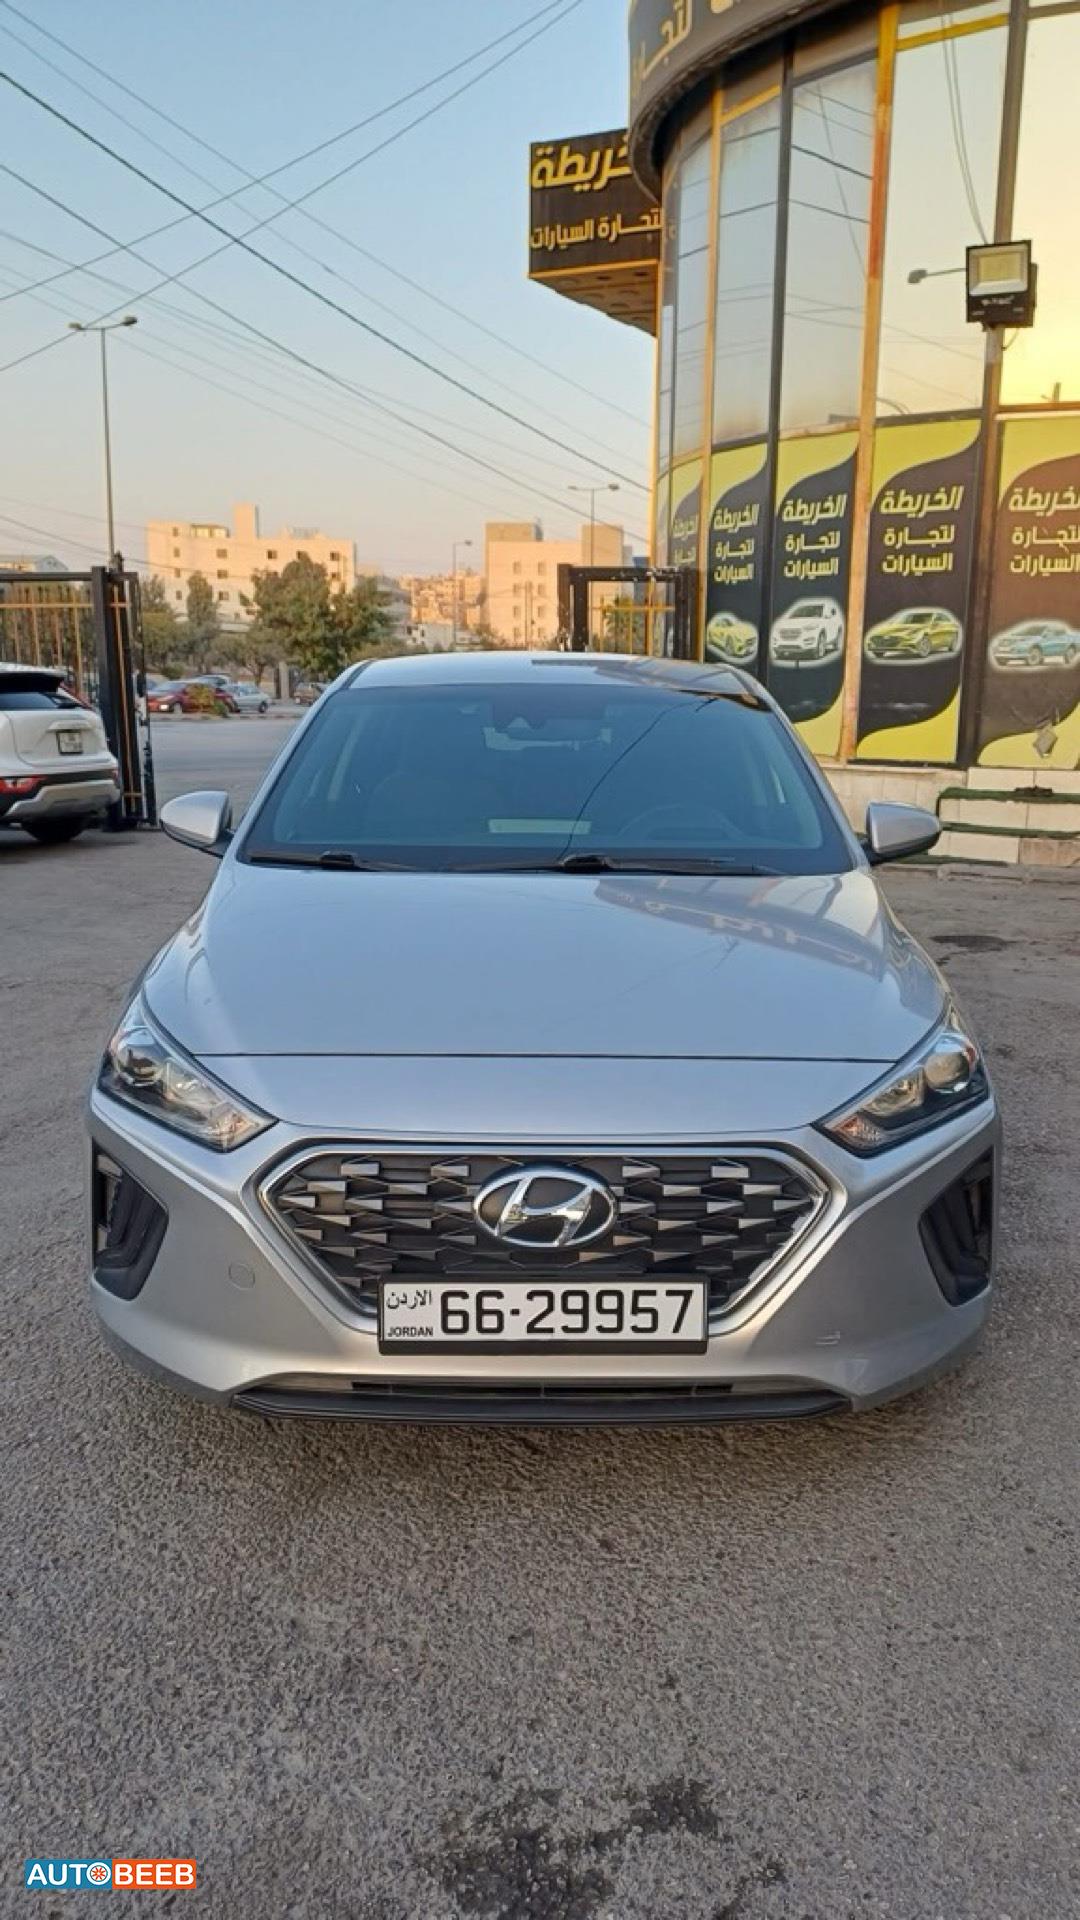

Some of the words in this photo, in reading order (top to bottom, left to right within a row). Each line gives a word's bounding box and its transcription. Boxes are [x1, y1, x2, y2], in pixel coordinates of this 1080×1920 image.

[782, 494, 847, 525] الخريطة
[880, 486, 965, 518] الخريطة
[714, 503, 760, 533] الخريطة
[785, 531, 841, 553] لتجارة
[884, 525, 955, 549] لتجارة
[715, 538, 755, 561] لتجارة
[714, 563, 755, 585] السيارات
[784, 557, 839, 580] السيارات
[882, 553, 954, 577] السيارات
[440, 1289, 694, 1334] 66-29957
[387, 1327, 434, 1338] JORDAN
